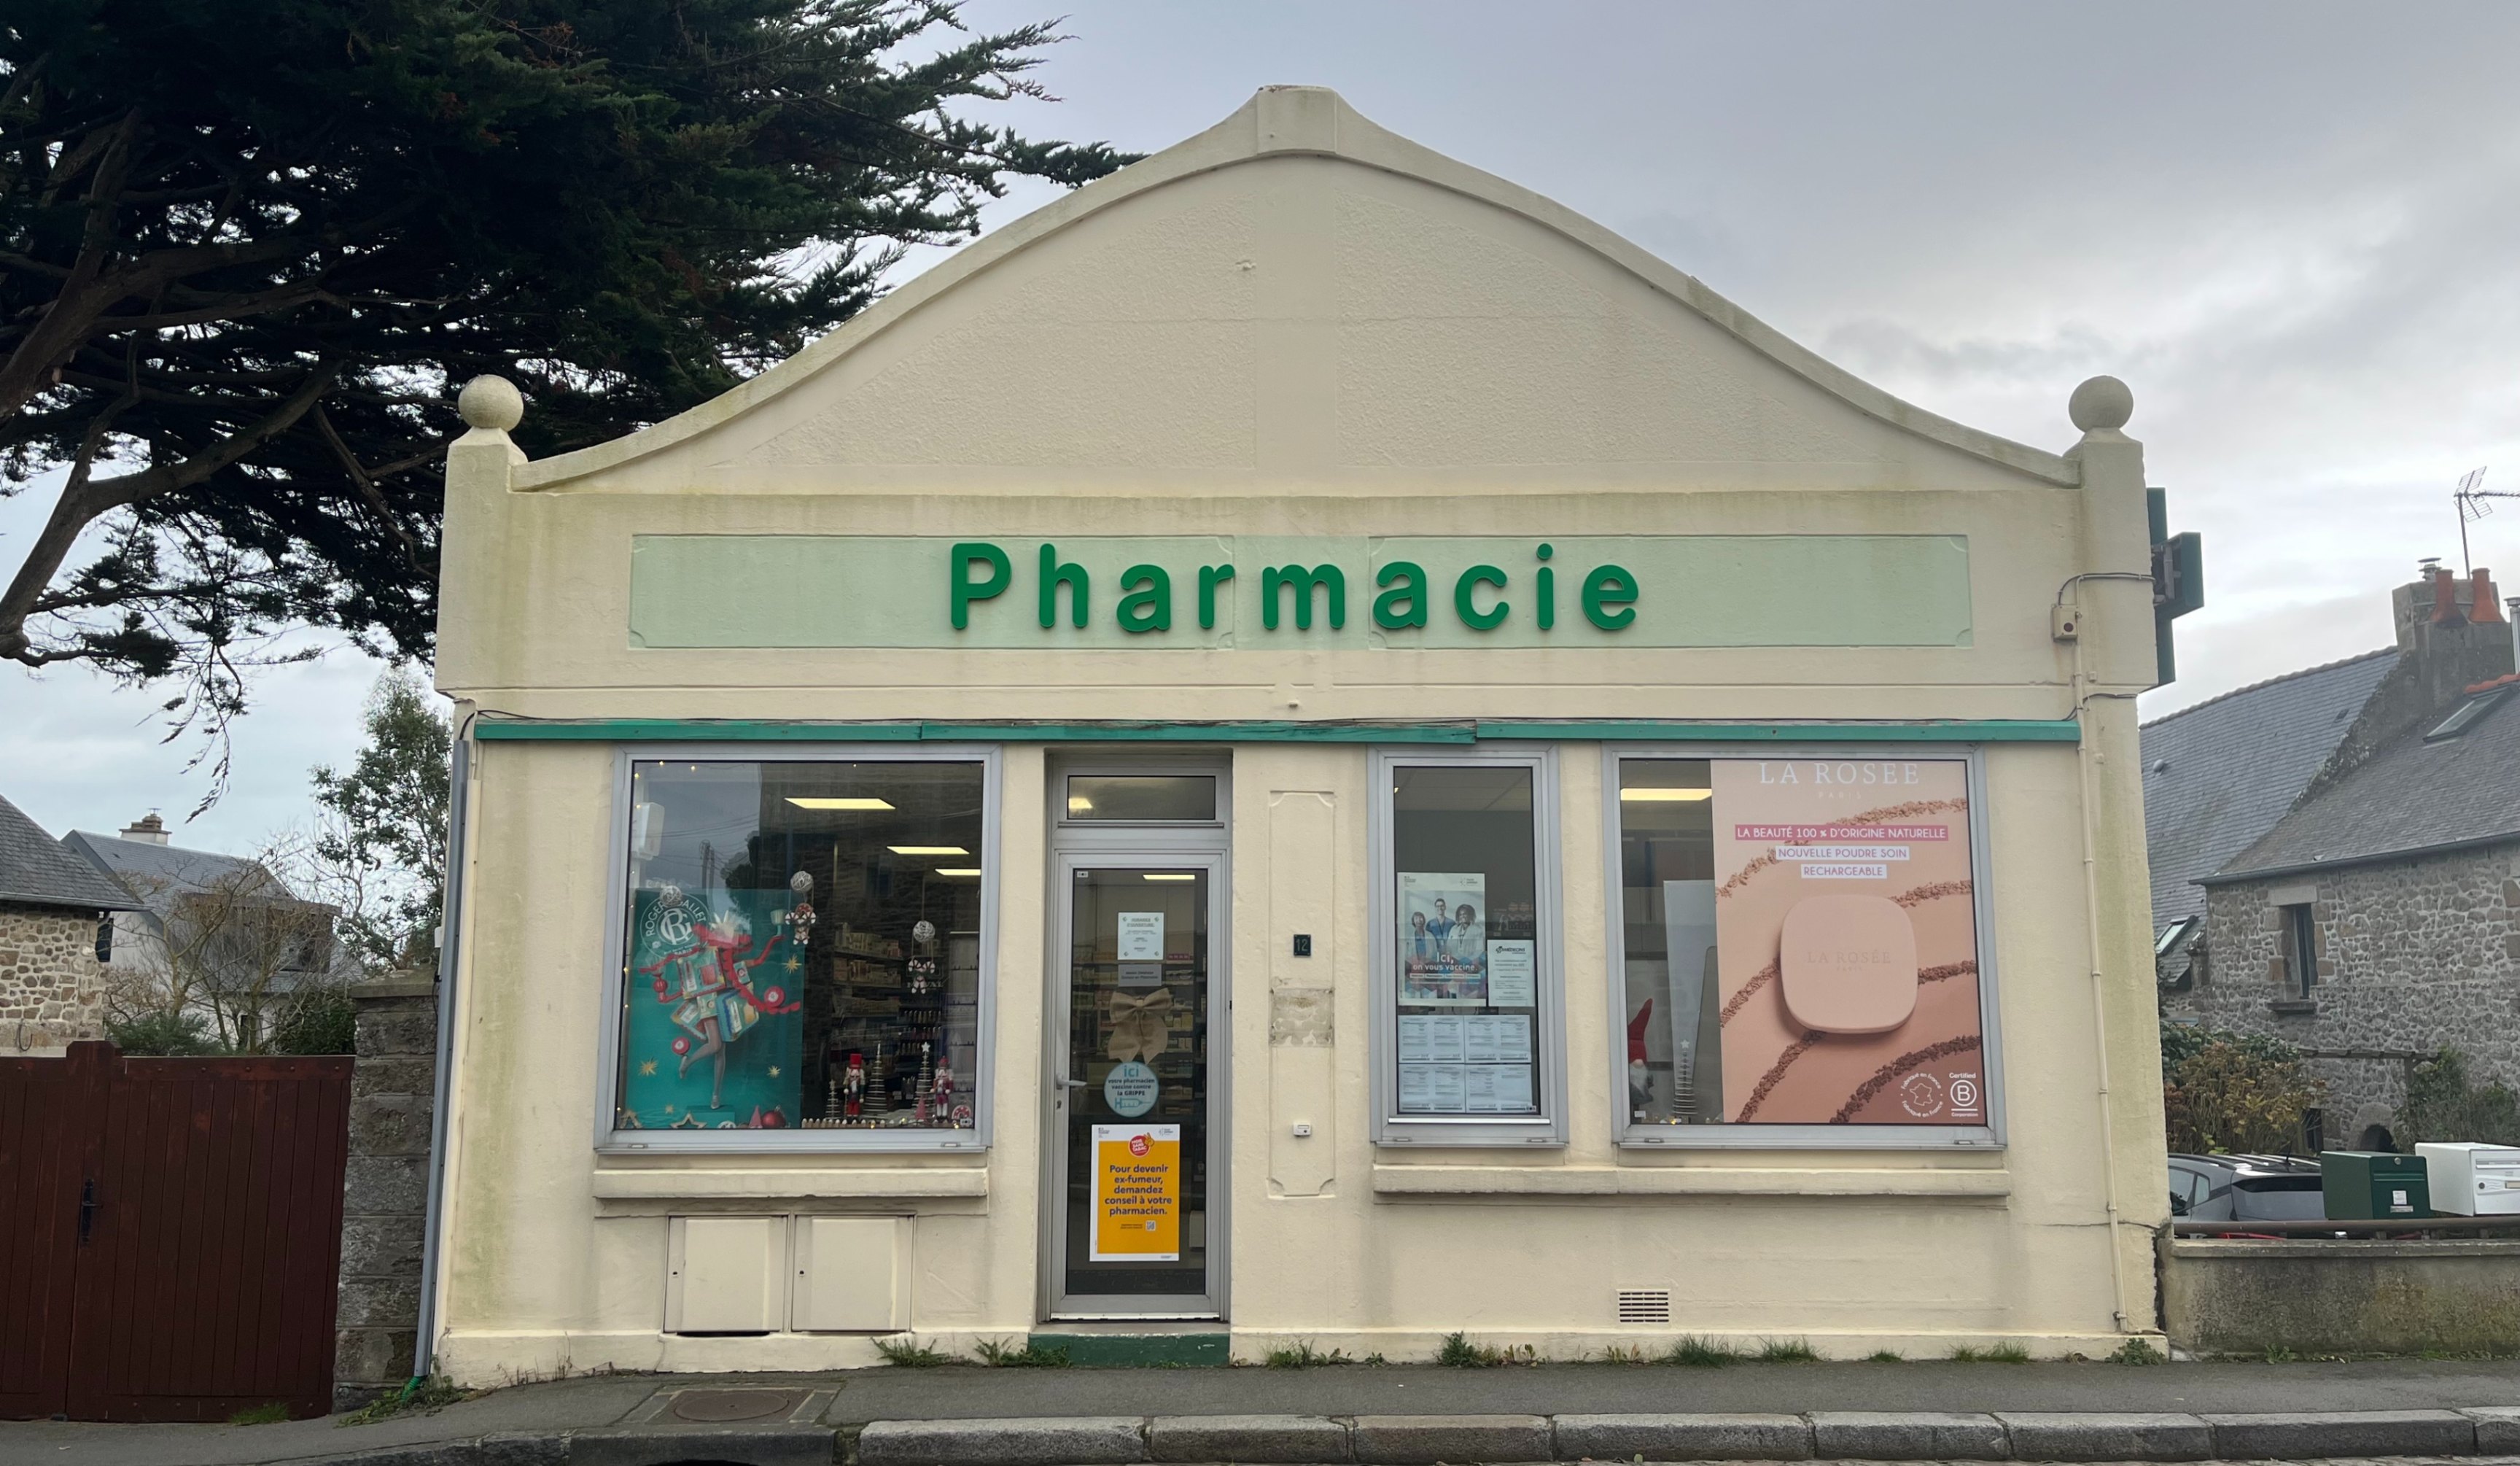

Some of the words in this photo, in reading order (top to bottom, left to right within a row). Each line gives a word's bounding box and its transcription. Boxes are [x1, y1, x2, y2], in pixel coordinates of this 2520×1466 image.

[952, 543, 1638, 630] Pharmacie
[1759, 763, 1799, 785] LA
[1819, 791, 1861, 799] PARIS
[1737, 829, 1751, 838] LA
[1754, 826, 1793, 838] BEAUTÉ
[1797, 829, 1816, 838] 100
[1830, 829, 1885, 839] D'ORIGINE
[1889, 830, 1946, 839] NATURELLE
[1778, 848, 1832, 858] NOUVELLE
[1835, 848, 1878, 858] POUDRE
[1881, 848, 1907, 858] SOIN
[1804, 866, 1883, 876] RECHARGEABLE
[1296, 939, 1309, 952] 12
[1807, 951, 1829, 963] LA
[1836, 949, 1891, 963] ROSÉE
[1124, 1065, 1139, 1077] ici
[1957, 1085, 1970, 1101] B
[1110, 1165, 1131, 1173] Pour
[1133, 1164, 1168, 1173] devenir
[1114, 1175, 1163, 1184] ex-fumeur,
[1114, 1185, 1163, 1194] demandez
[1105, 1196, 1138, 1204] conseil
[1140, 1196, 1145, 1204] à
[1110, 1206, 1167, 1217] pharmacien.
